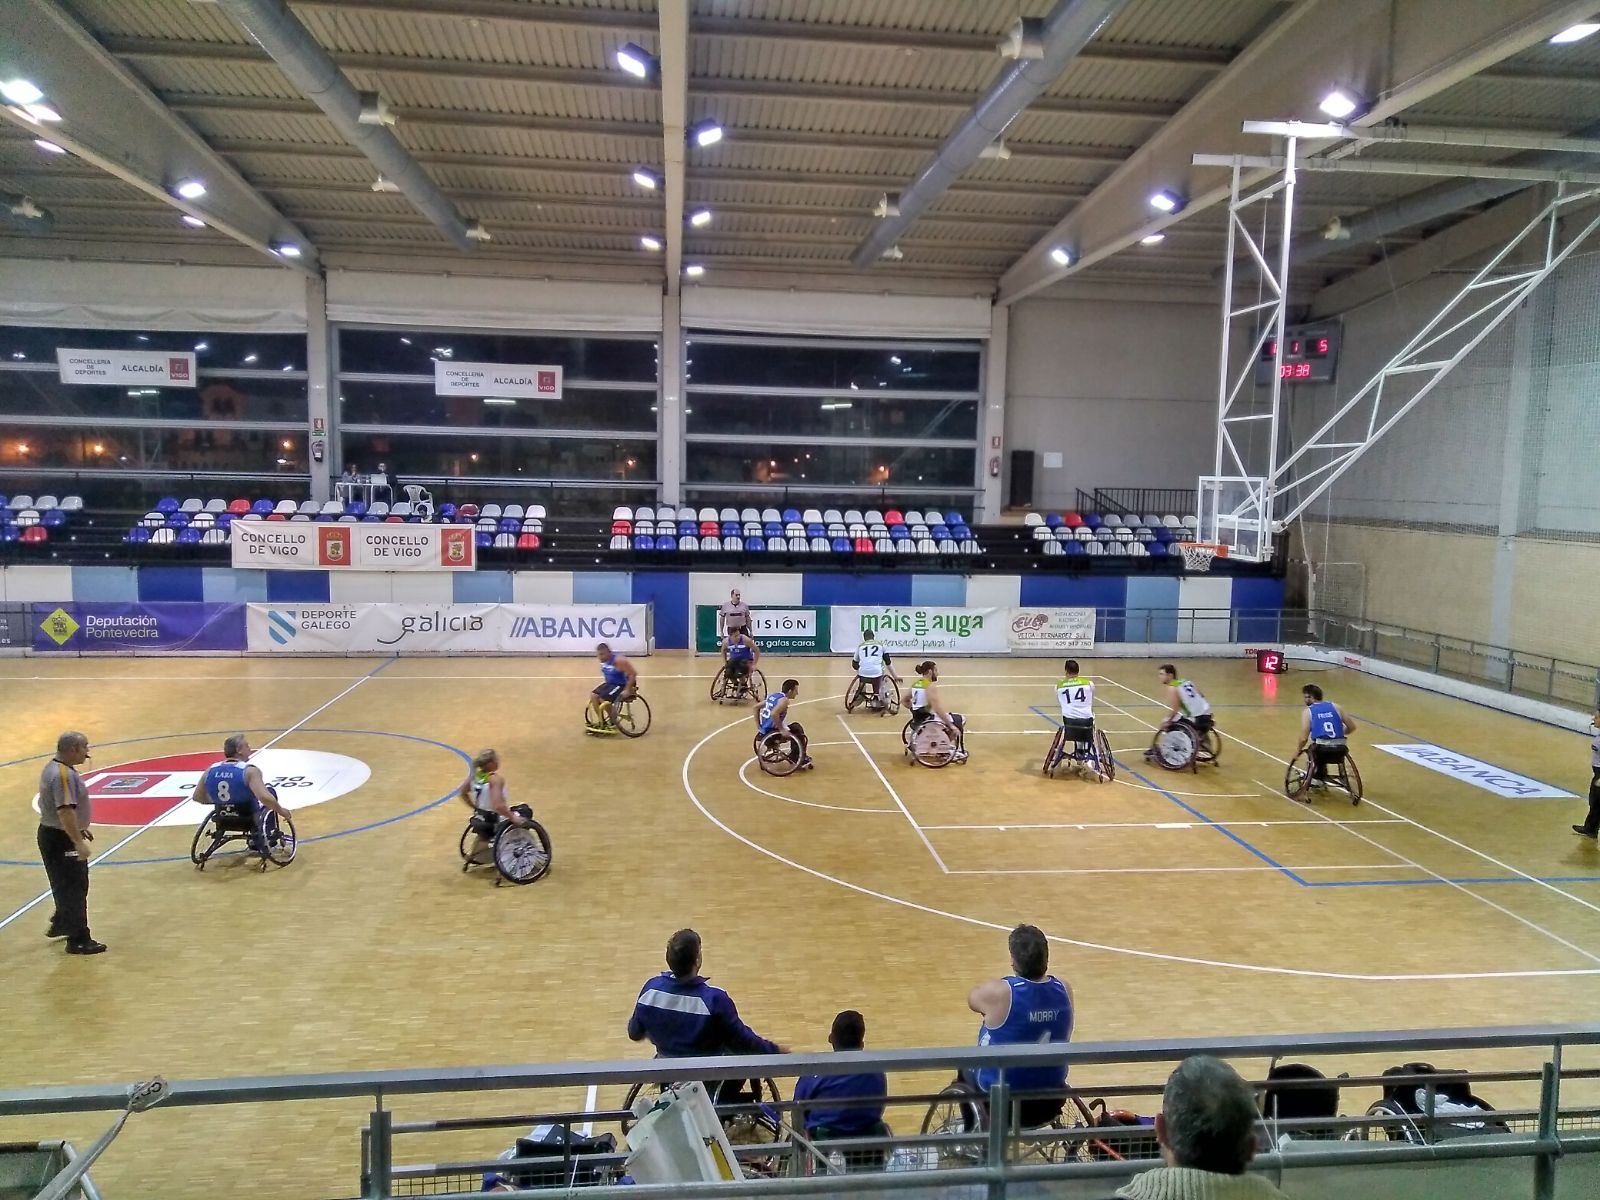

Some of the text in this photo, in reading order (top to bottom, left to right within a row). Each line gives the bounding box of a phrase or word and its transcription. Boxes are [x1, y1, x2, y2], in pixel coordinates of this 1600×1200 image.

[121, 364, 164, 373] ALCALDÍA
[493, 377, 533, 385] ALCALDÍA
[241, 532, 306, 544] CONCELLO
[366, 535, 429, 546] CONCELLO
[249, 545, 298, 556] DE VIGO
[374, 548, 422, 557] DE VIGO
[302, 610, 357, 619] DEPORTE
[860, 608, 911, 632] máis
[86, 615, 157, 627] Deputación
[301, 620, 350, 630] GALEGO
[390, 611, 484, 638] galicia
[932, 614, 984, 638] auga
[86, 627, 159, 638] Pontevedra
[862, 645, 879, 658] 12
[1265, 656, 1278, 670] 12
[1062, 687, 1086, 704] 14
[1324, 721, 1336, 738] 9
[218, 780, 231, 802] 8
